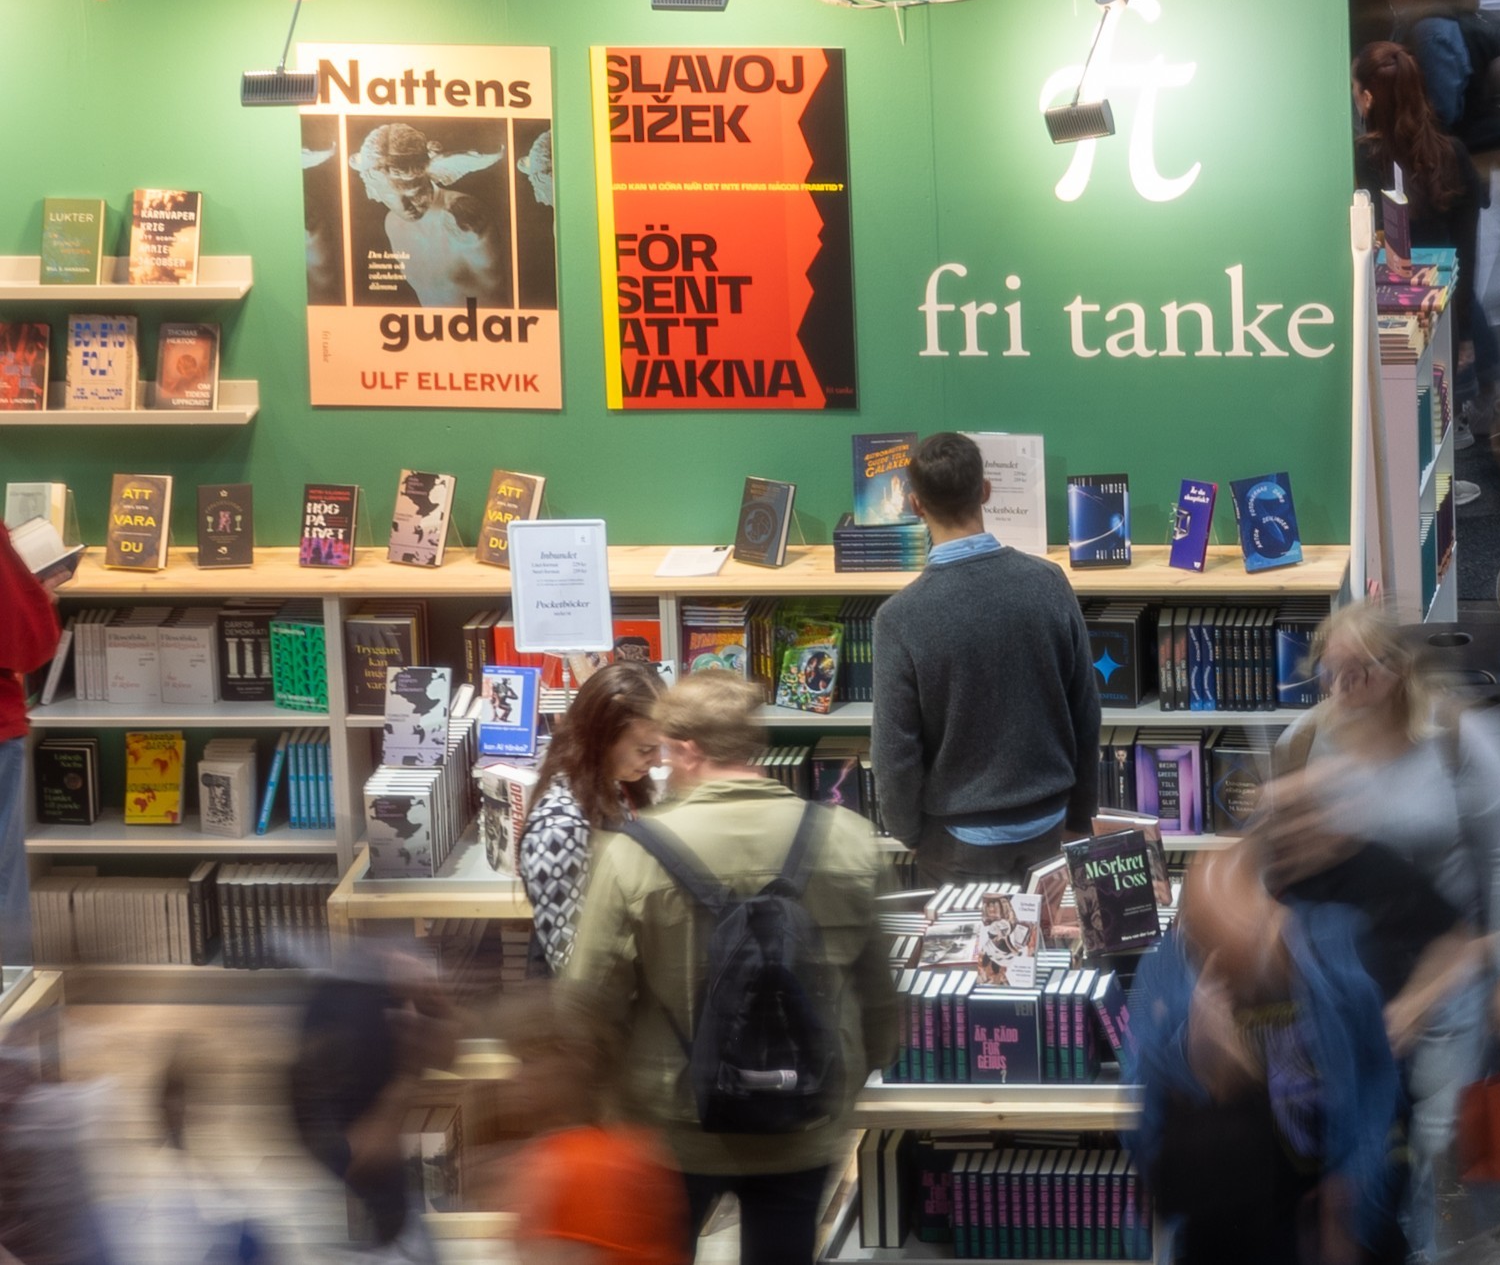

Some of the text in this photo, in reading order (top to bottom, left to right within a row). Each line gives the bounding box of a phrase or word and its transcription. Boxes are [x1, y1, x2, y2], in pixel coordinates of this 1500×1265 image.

[318, 59, 533, 109] Nattens
[606, 55, 805, 95] SLAVOJ
[608, 94, 752, 144] ŽIŽEK
[628, 184, 647, 192] KAN
[658, 182, 683, 192] GÖRA
[703, 184, 720, 192] DET
[50, 212, 94, 223] LUKTER
[616, 224, 719, 272] FÖR
[618, 276, 753, 314] SENT
[379, 297, 540, 353] gudar
[918, 263, 1337, 360] fri tanke
[620, 318, 719, 356] ATT
[360, 371, 541, 393] ULF ELLERVIK
[622, 359, 807, 398] VAKNA
[122, 488, 153, 500] ATT
[498, 484, 524, 499] ATT
[114, 514, 157, 527] VARA
[121, 540, 143, 553] DU
[536, 600, 590, 610] Pocketböcker
[1085, 853, 1145, 881] Mörkret
[1122, 871, 1148, 888] oss
